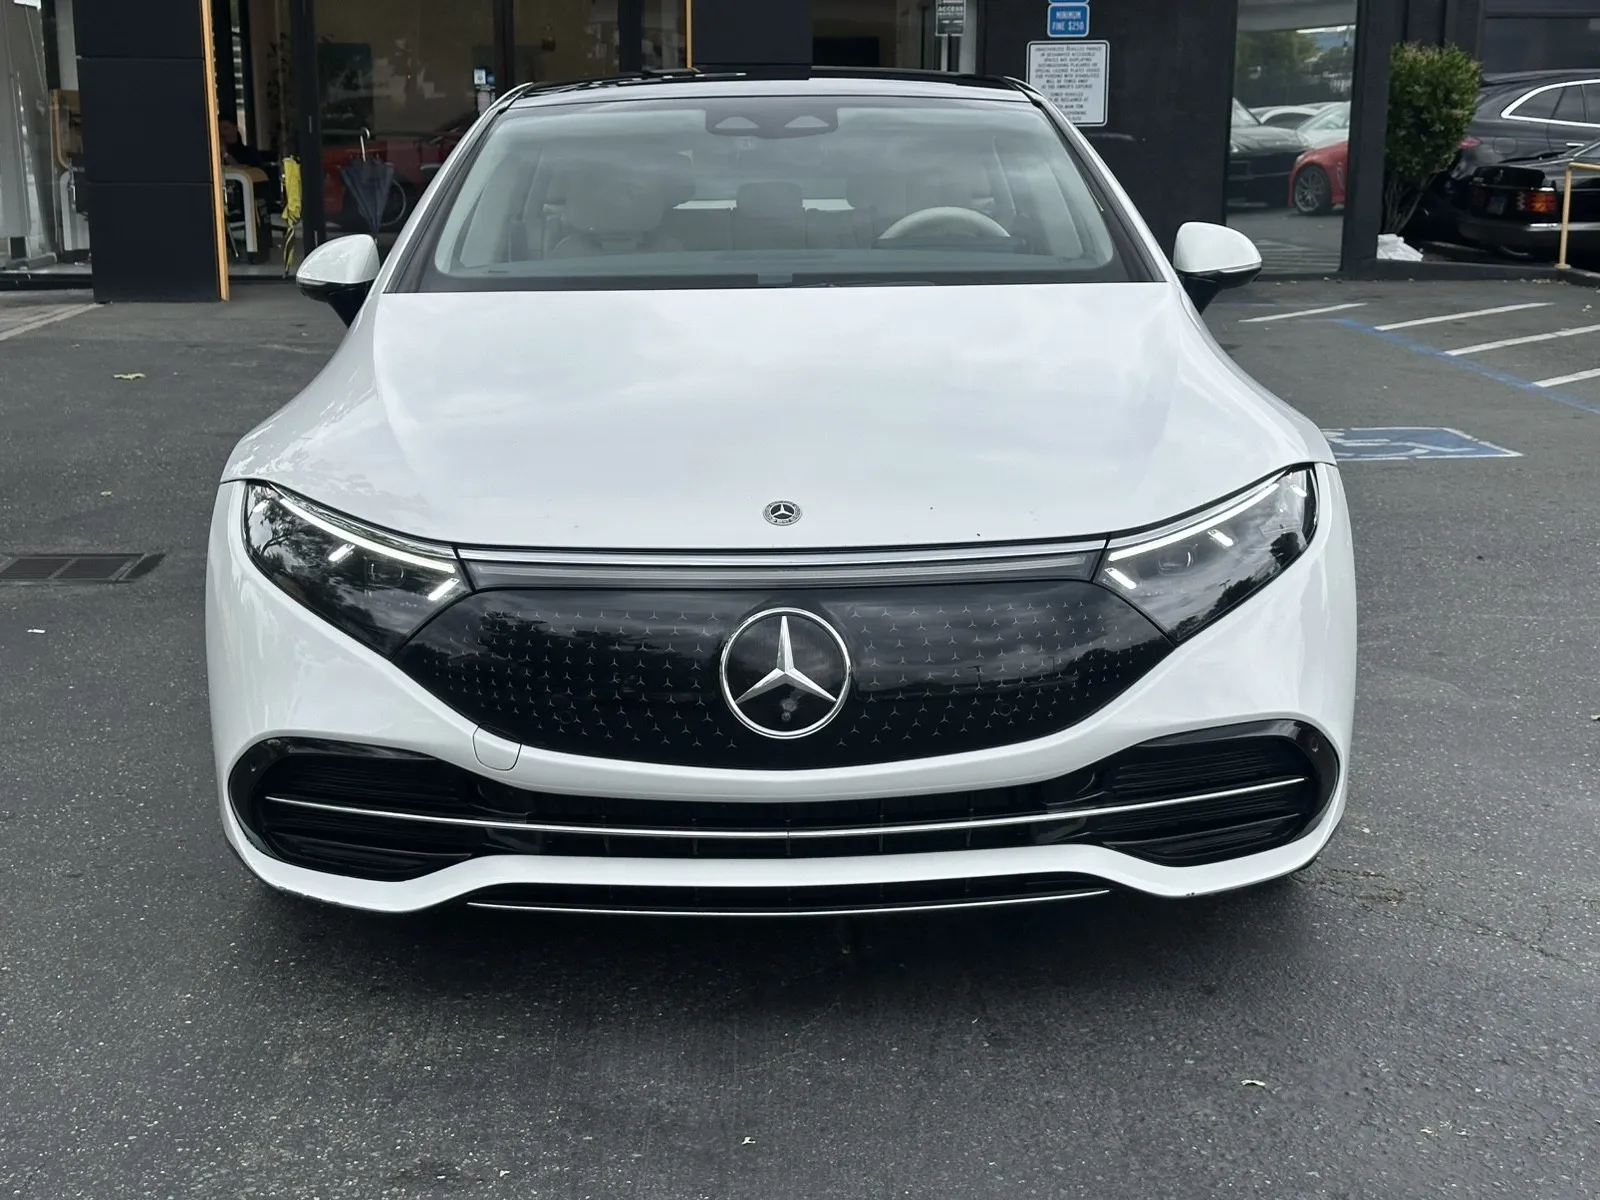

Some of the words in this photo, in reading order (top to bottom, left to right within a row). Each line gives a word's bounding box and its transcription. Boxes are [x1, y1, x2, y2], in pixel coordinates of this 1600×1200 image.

[1056, 11, 1082, 19] MINIMUM
[1052, 21, 1065, 30] FINE
[1068, 21, 1084, 31] $250
